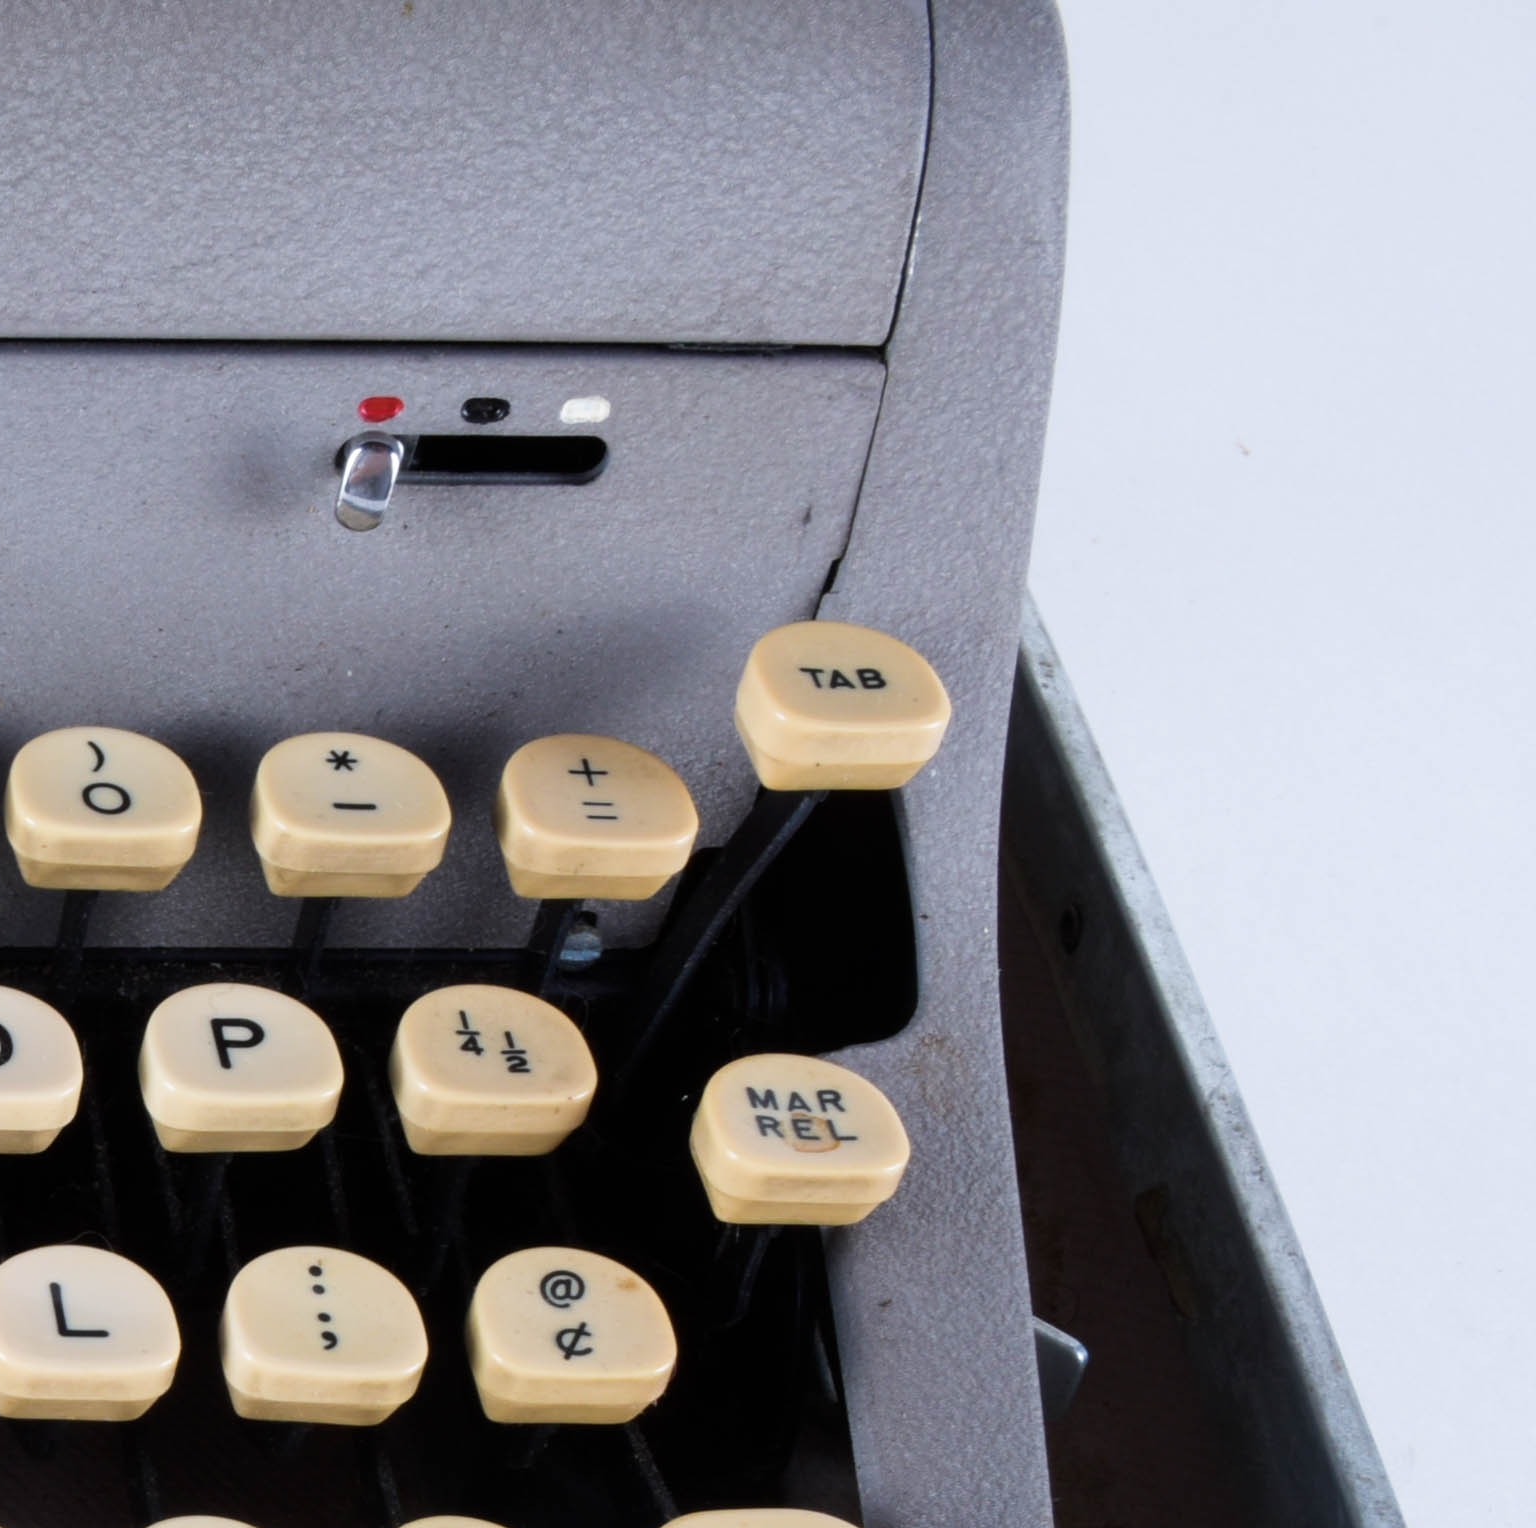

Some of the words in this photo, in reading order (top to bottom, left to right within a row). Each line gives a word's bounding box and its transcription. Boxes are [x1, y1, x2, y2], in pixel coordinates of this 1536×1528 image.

[797, 665, 889, 692] TAB
[85, 739, 108, 775] )
[565, 755, 611, 789] +
[207, 1015, 268, 1072] P
[744, 1084, 848, 1115] MAR
[753, 1113, 860, 1145] REL
[537, 1267, 588, 1311] @
[47, 1280, 112, 1341] L
[552, 1319, 595, 1363] ¢
